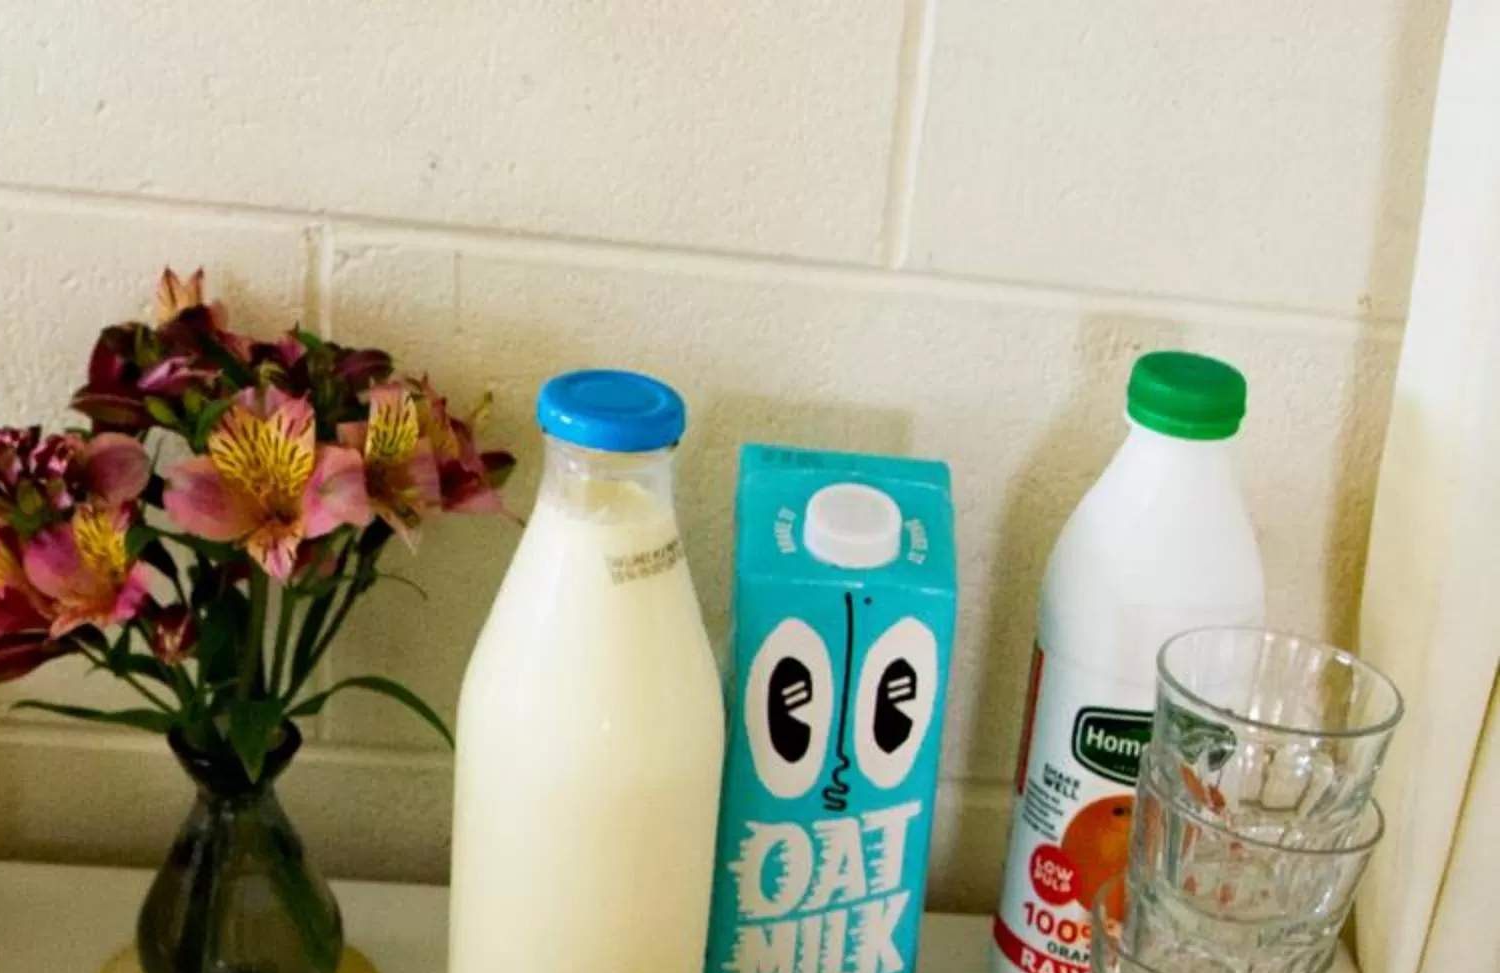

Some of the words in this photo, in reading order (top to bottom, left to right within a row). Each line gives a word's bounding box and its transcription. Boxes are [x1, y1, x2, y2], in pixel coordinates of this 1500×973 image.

[1044, 775, 1079, 800] WELL
[728, 799, 922, 919] OAT
[1036, 854, 1074, 879] LOW
[1034, 864, 1071, 893] PULP
